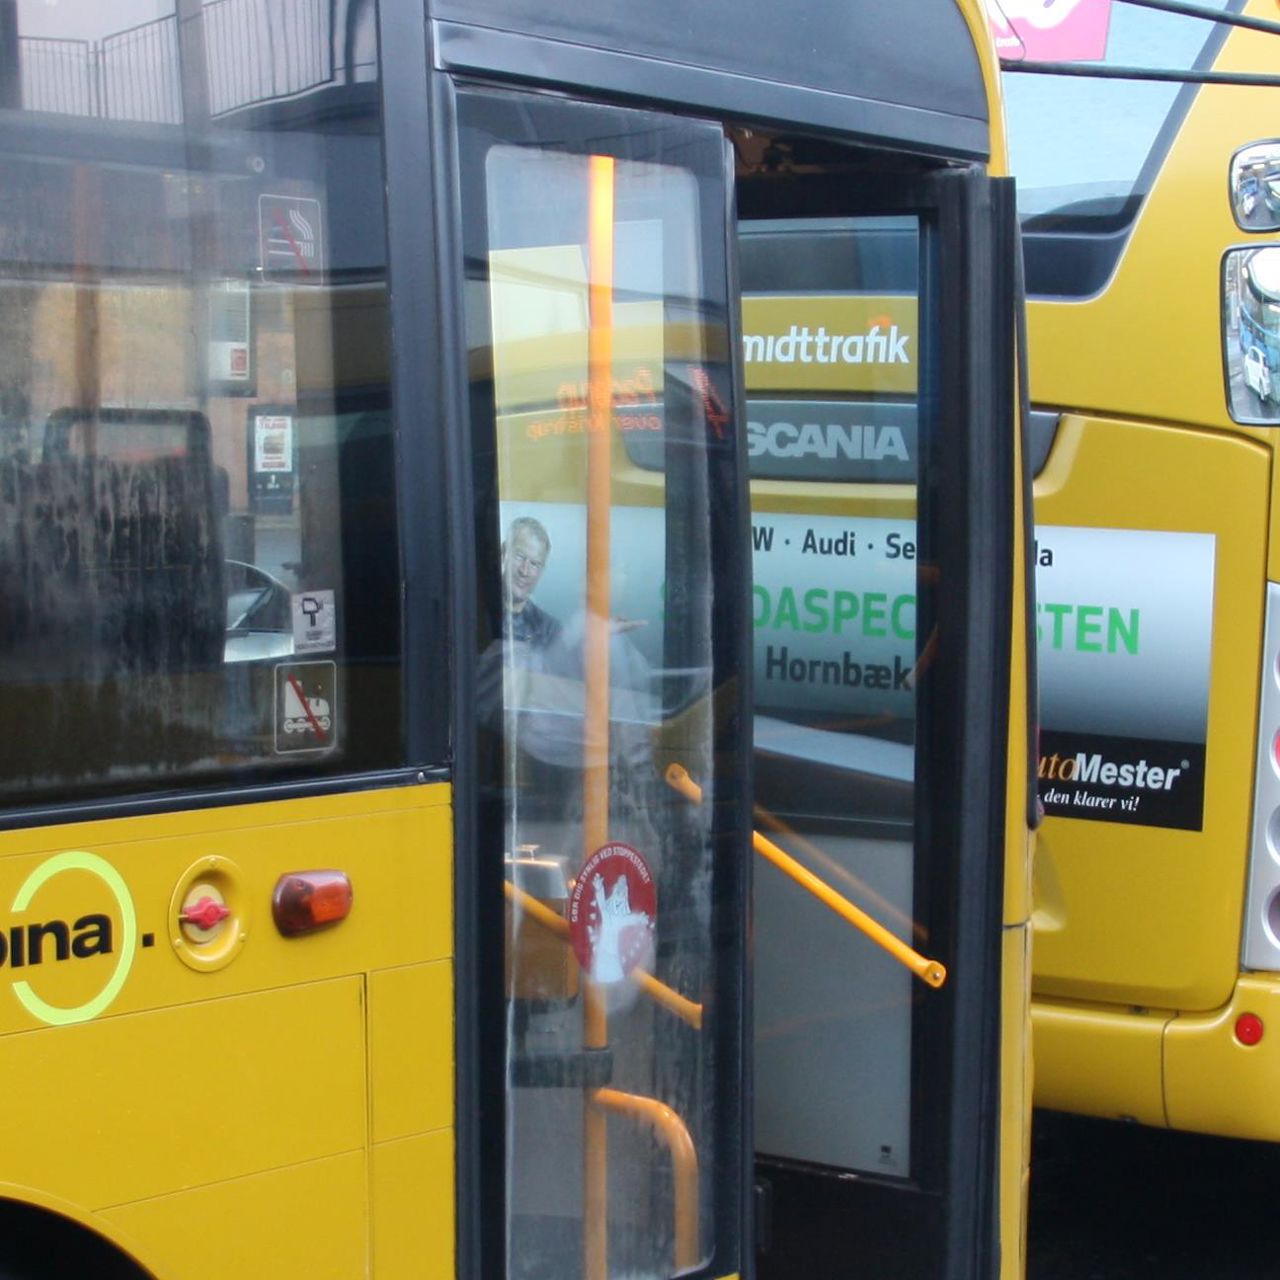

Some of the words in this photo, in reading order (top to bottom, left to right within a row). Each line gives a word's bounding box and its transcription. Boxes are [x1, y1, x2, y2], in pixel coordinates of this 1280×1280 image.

[742, 325, 910, 363] midttrafik
[746, 421, 910, 461] SCANIA
[802, 529, 856, 556] Audi
[766, 646, 913, 692] Hornbæk
[1044, 788, 1070, 804] den
[1073, 790, 1117, 809] klarer
